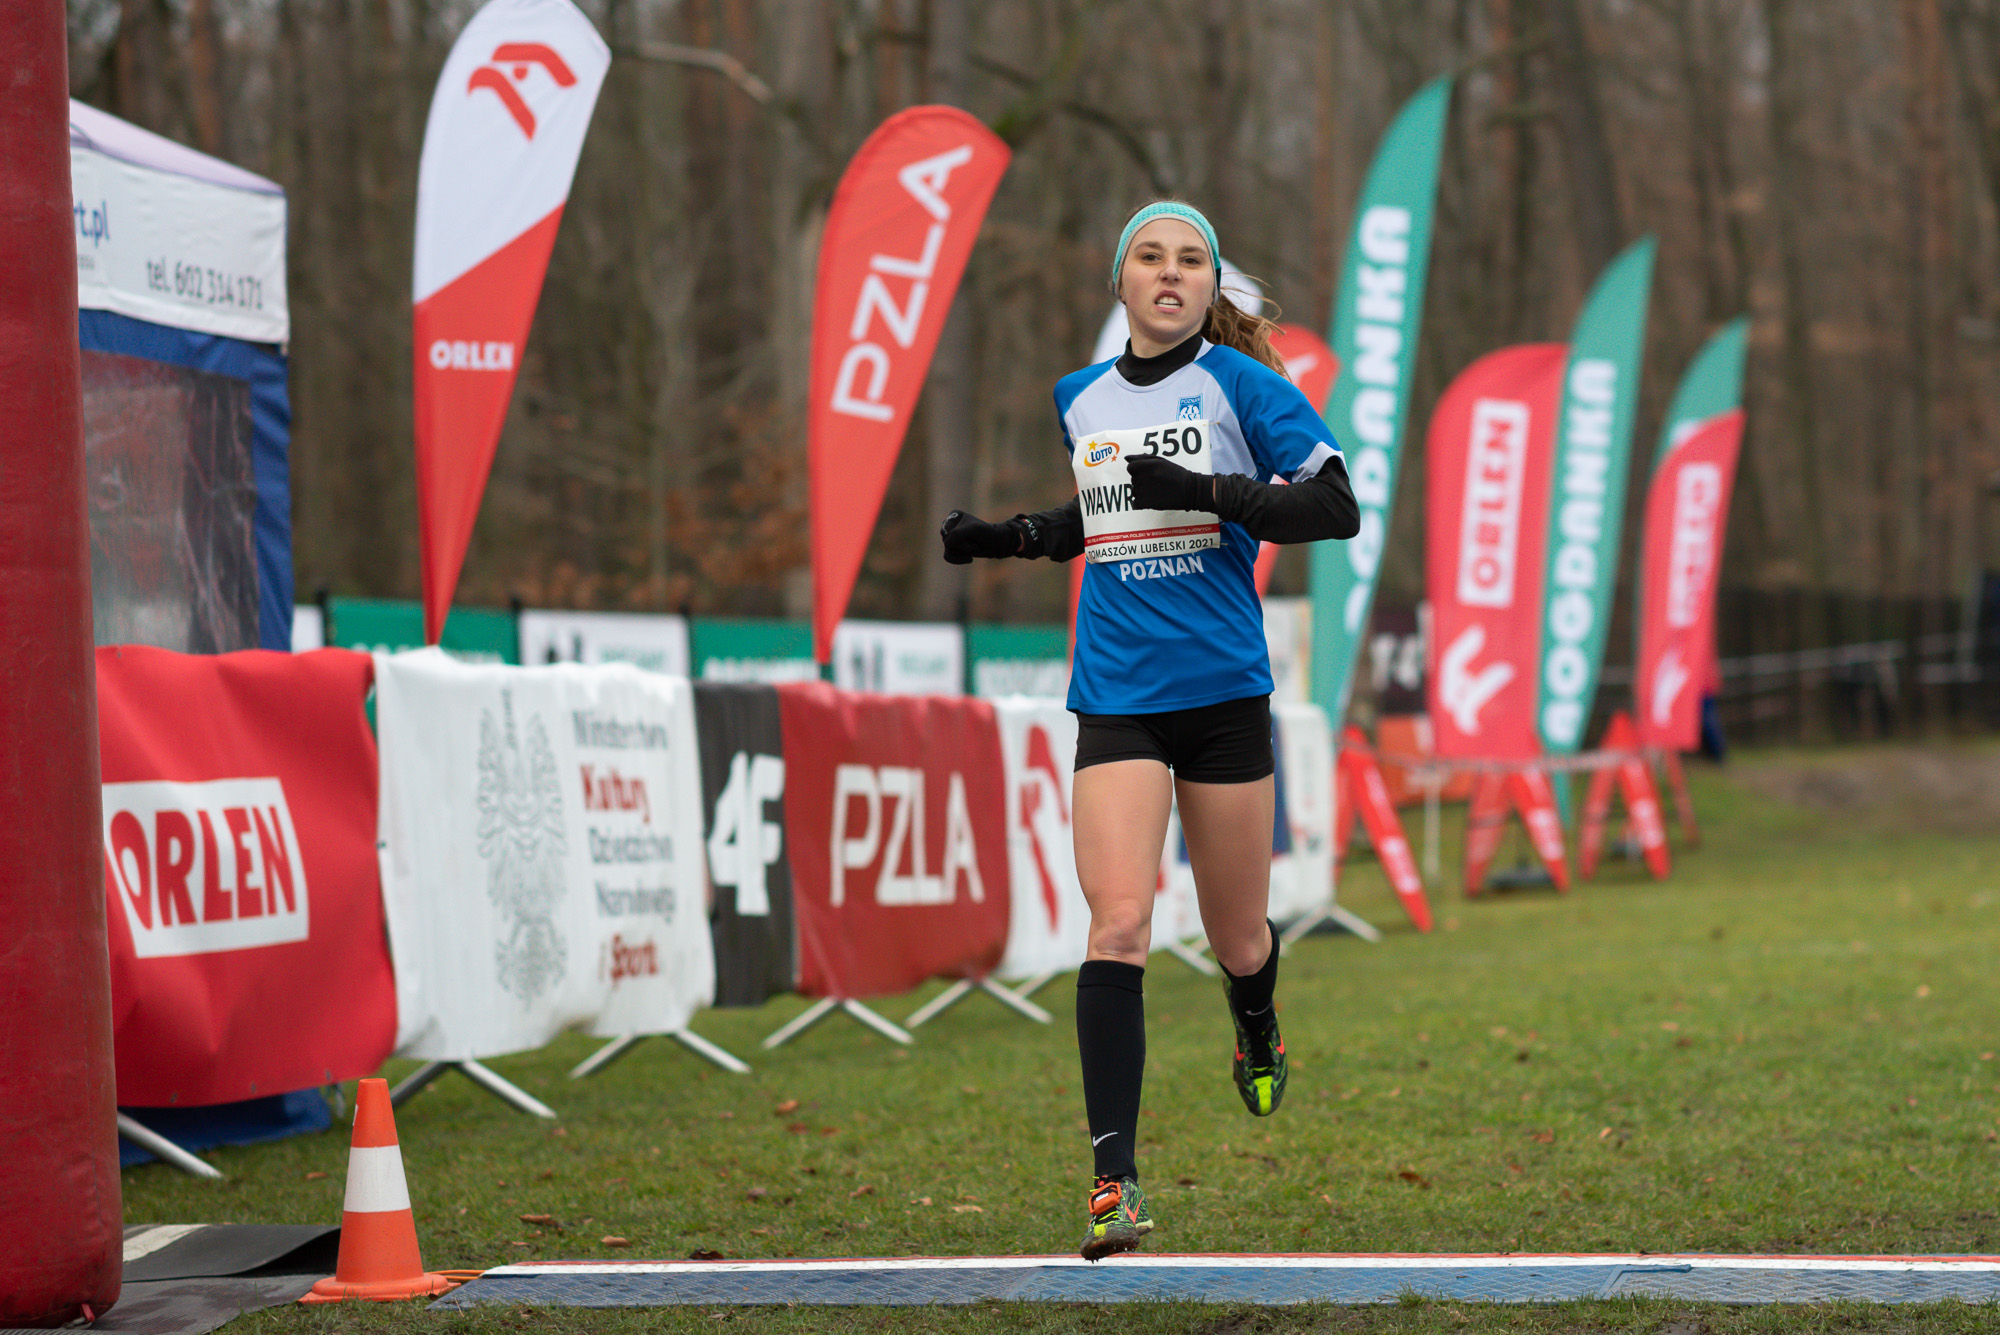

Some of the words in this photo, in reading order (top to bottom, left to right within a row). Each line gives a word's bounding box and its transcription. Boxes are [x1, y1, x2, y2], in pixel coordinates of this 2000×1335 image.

[175, 261, 203, 298] 602
[207, 269, 233, 305] 314
[831, 145, 973, 422] PZLA
[429, 339, 515, 370] ORLEN
[1090, 446, 1113, 463] LOTTO
[1143, 426, 1203, 457] 550
[1081, 484, 1134, 517] WAWR
[1088, 543, 1138, 560] TOMASZÓW
[1140, 540, 1186, 554] LUBELSKI
[1189, 538, 1214, 549] 2021
[708, 751, 786, 916] 4F
[830, 764, 985, 908] PZLA
[110, 805, 297, 931] ORLEN
